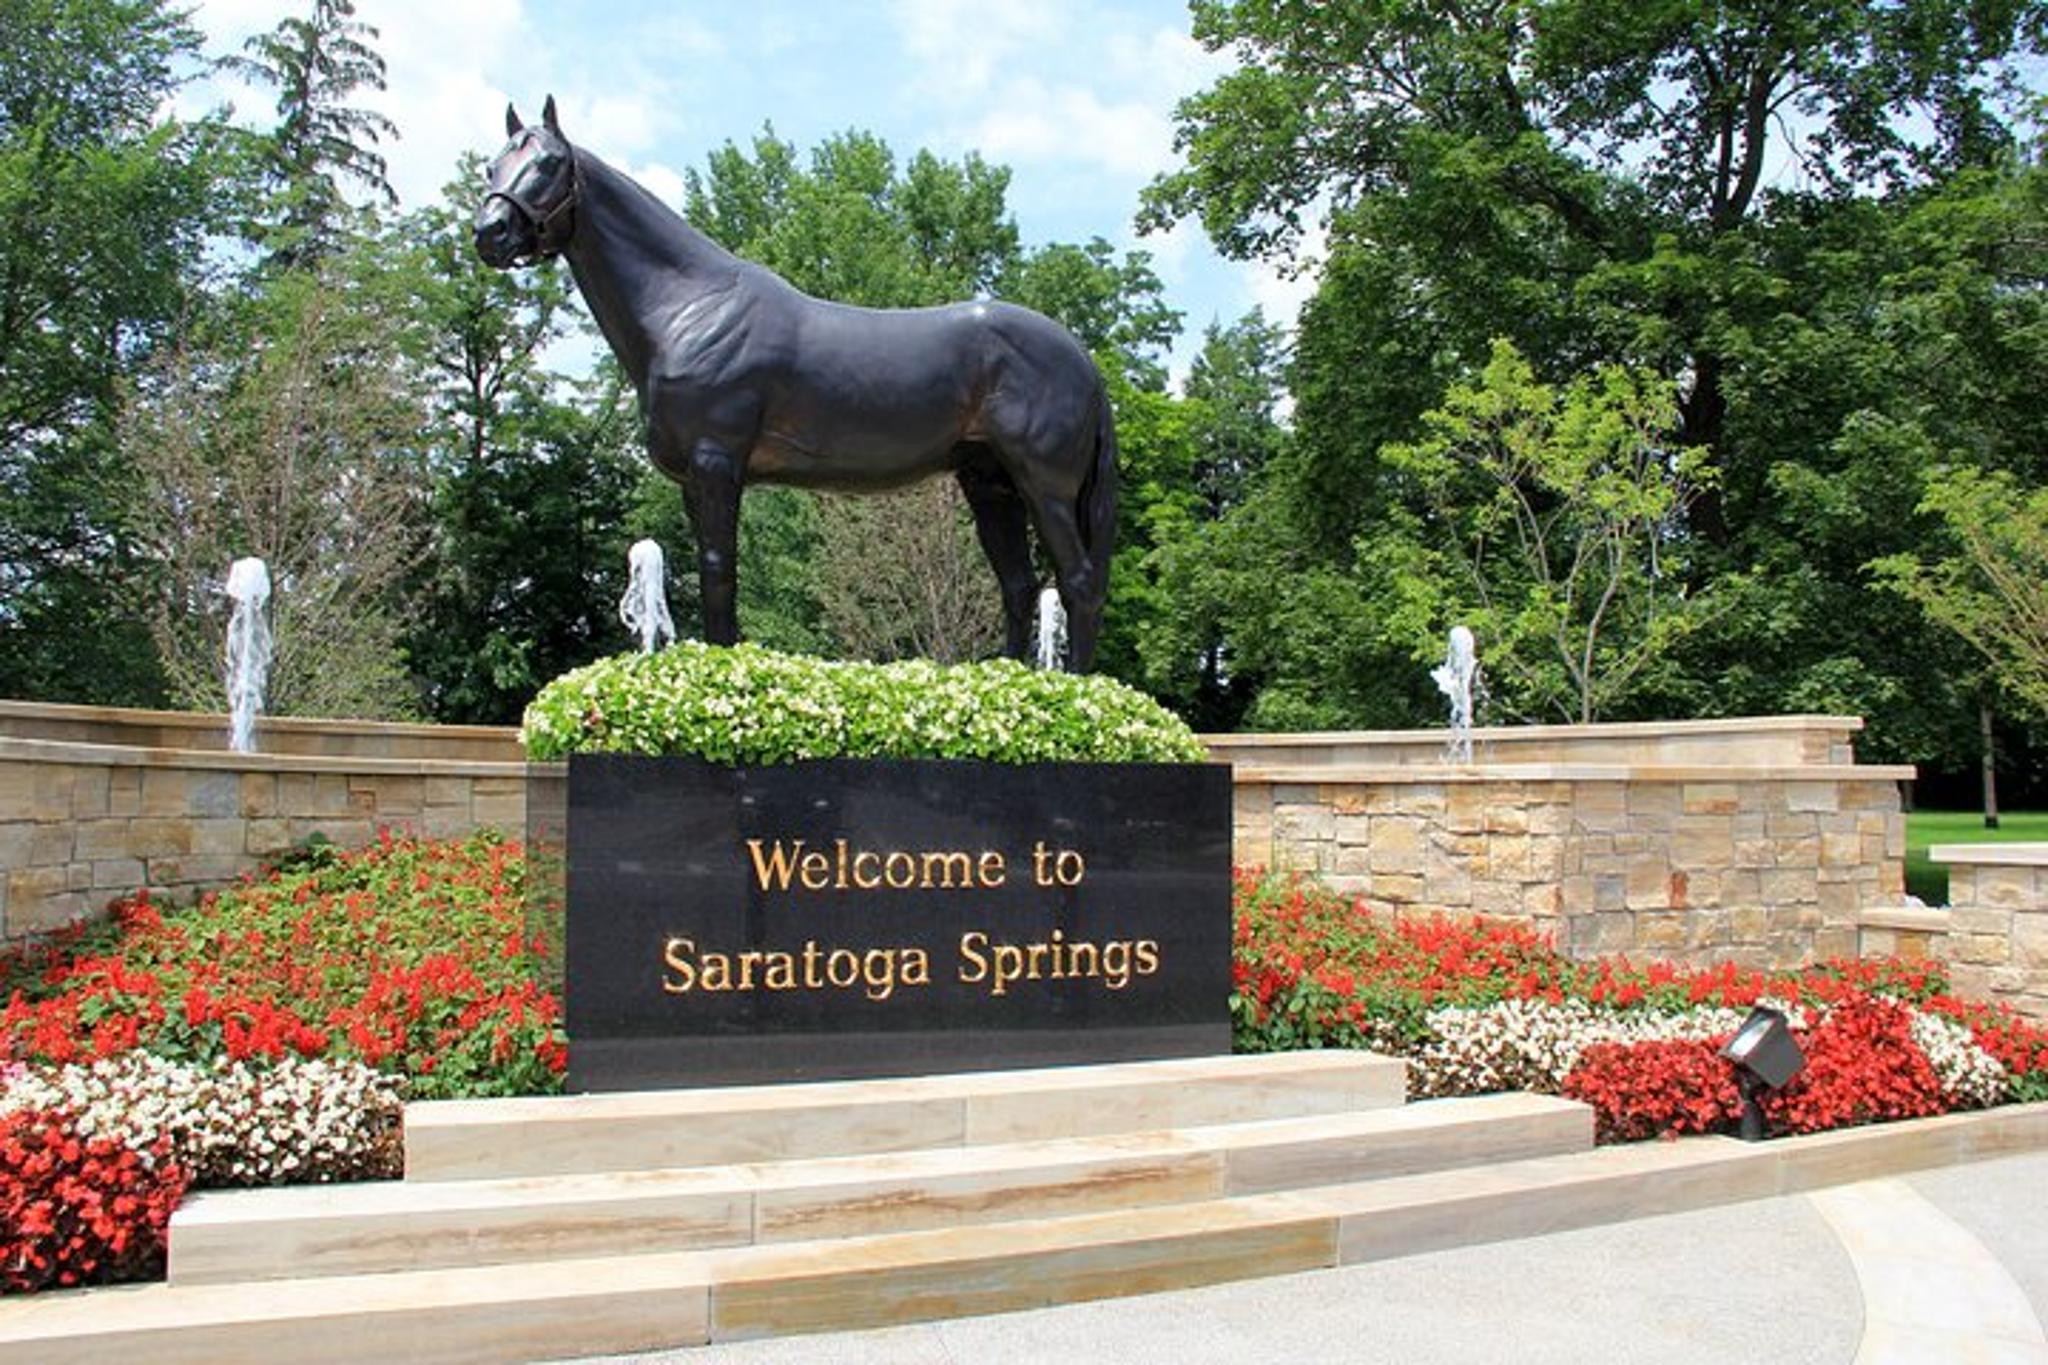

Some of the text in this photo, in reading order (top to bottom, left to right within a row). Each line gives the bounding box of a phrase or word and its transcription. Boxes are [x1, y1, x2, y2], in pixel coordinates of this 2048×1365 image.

[746, 839, 1085, 891] Welcome to
[663, 929, 1160, 1001] Saratoga Springs
